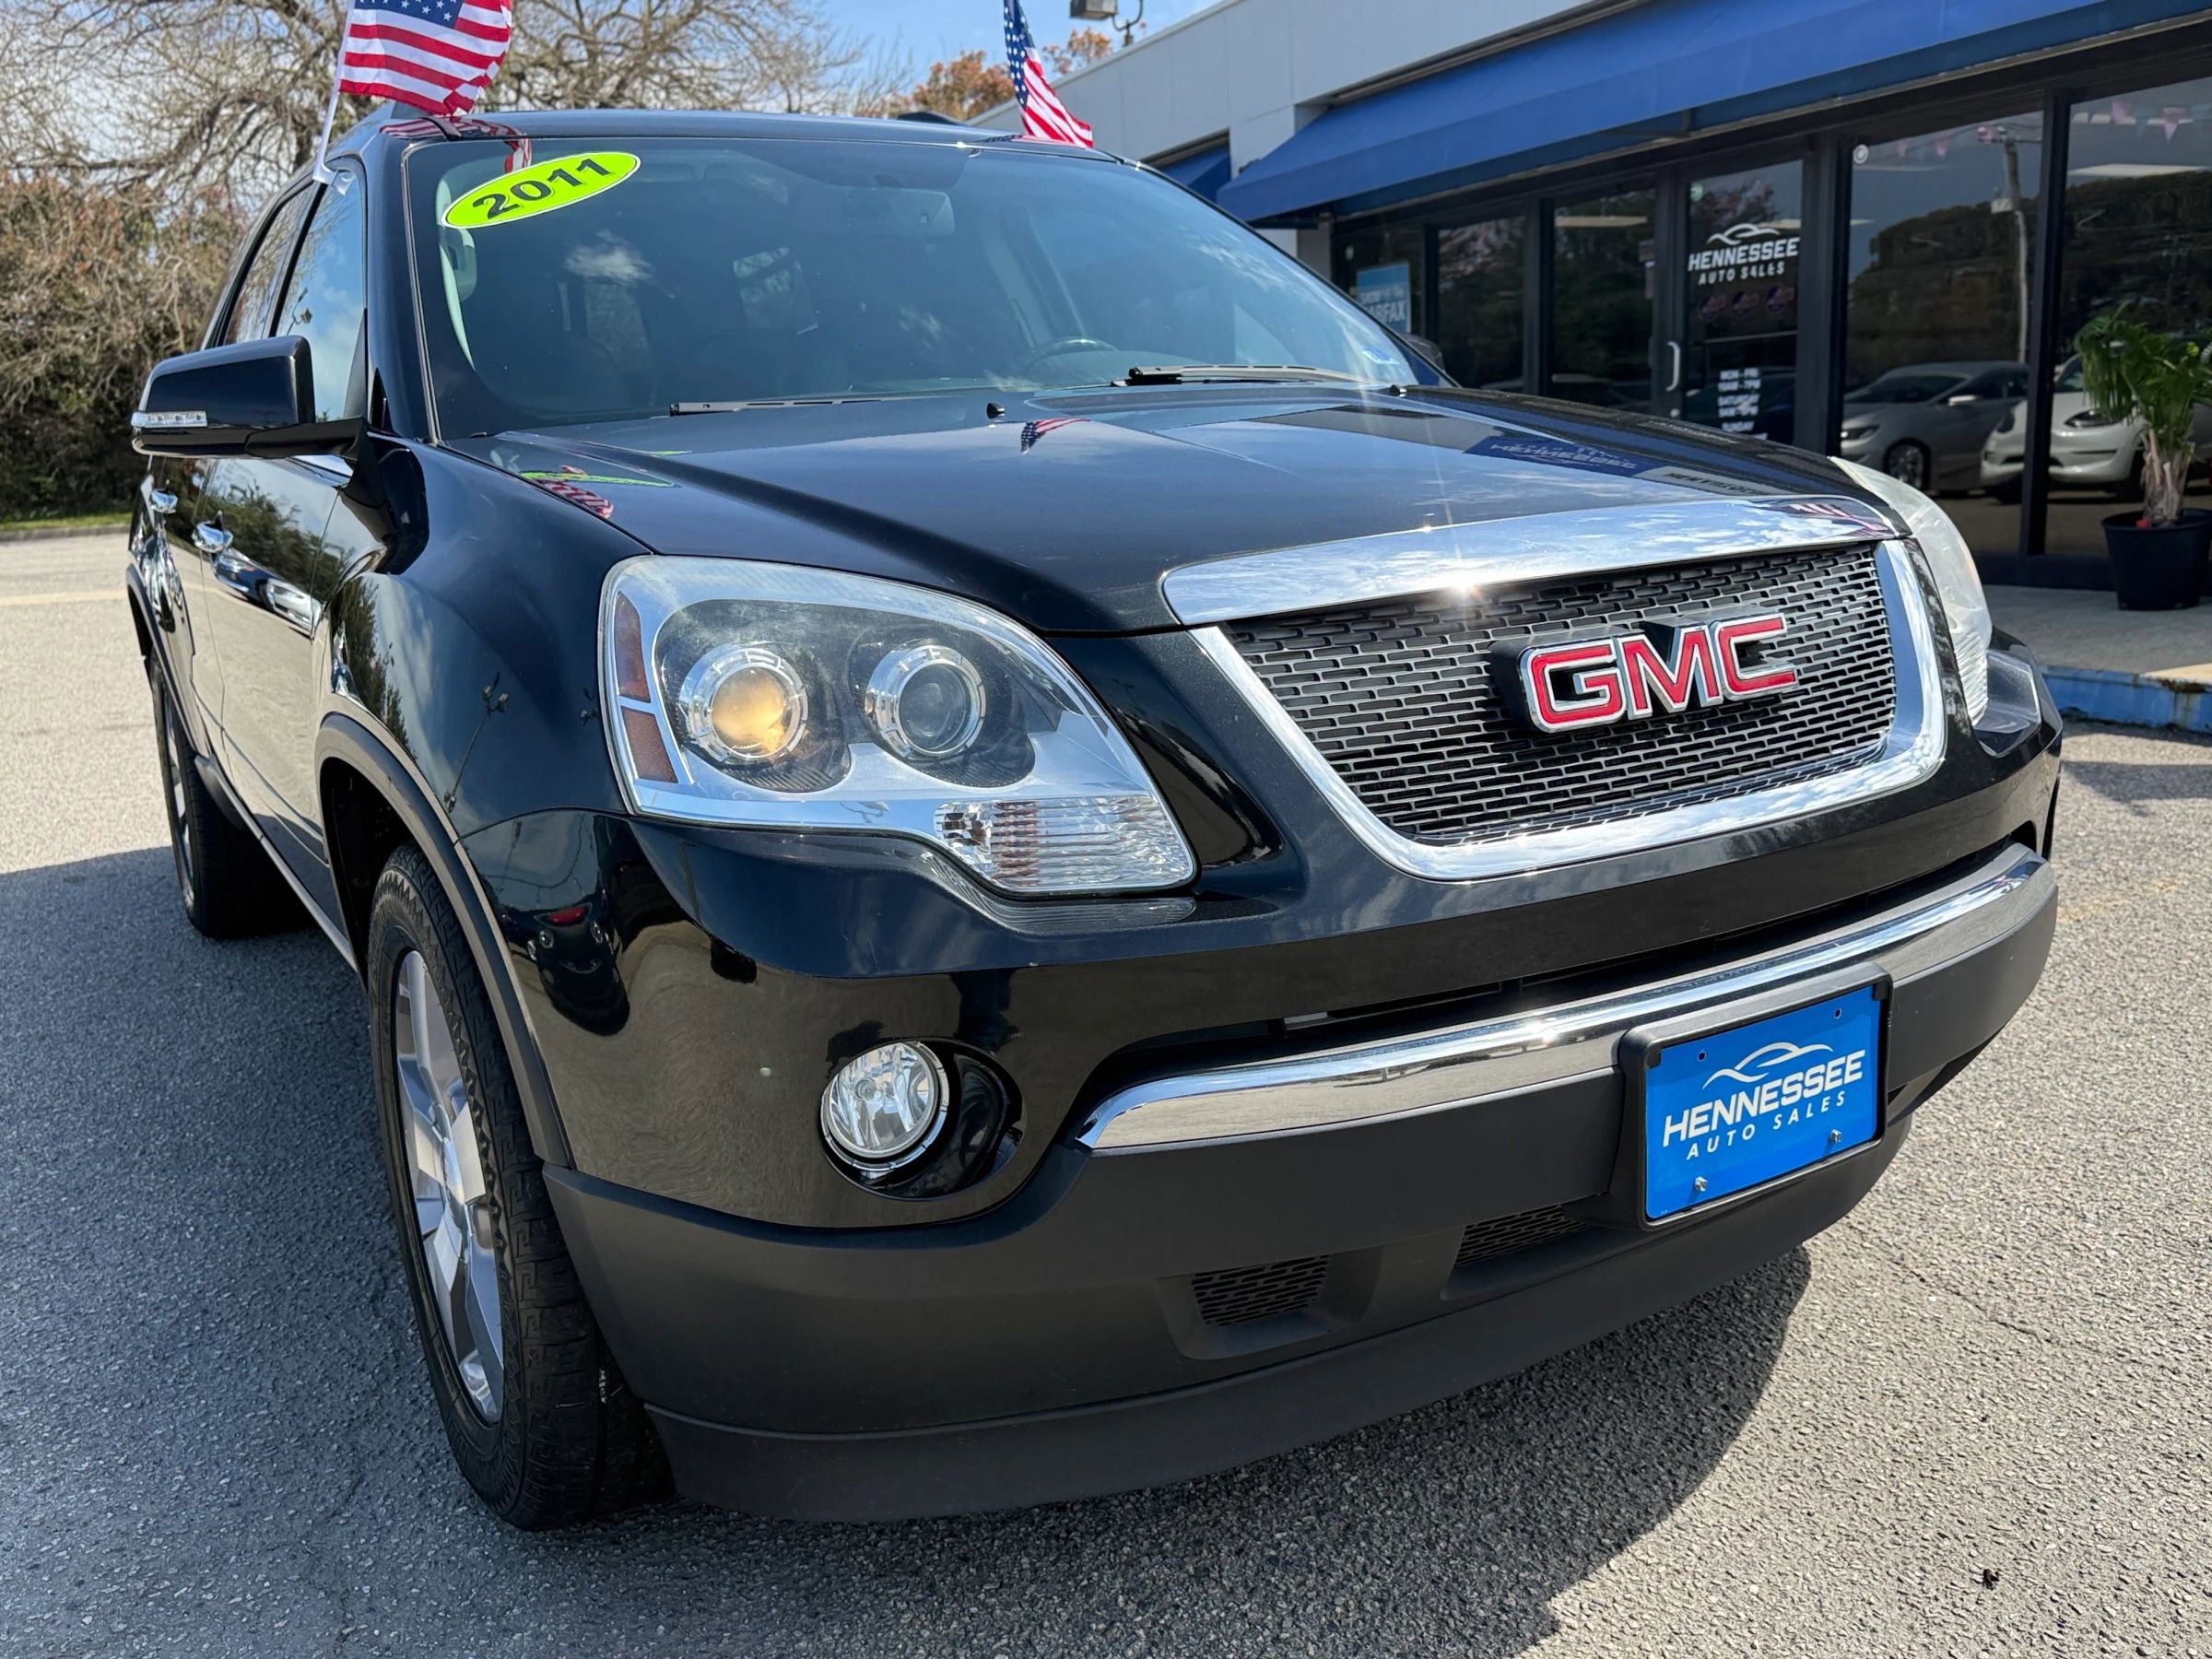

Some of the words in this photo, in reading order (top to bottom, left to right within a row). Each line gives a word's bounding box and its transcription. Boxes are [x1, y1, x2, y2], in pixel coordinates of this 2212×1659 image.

[472, 158, 612, 219] 2011
[1688, 237, 1801, 271] HENNESSEE
[1698, 268, 1736, 286] AUTO
[1740, 261, 1785, 280] SALES
[1363, 300, 1406, 324] ARFAX
[1717, 394, 1760, 406] SATURDAY
[1521, 613, 1798, 733] GMC
[1663, 1050, 1866, 1147] HENNESSEE
[1686, 1124, 1756, 1160] AUTO
[1772, 1090, 1846, 1130] SALES
